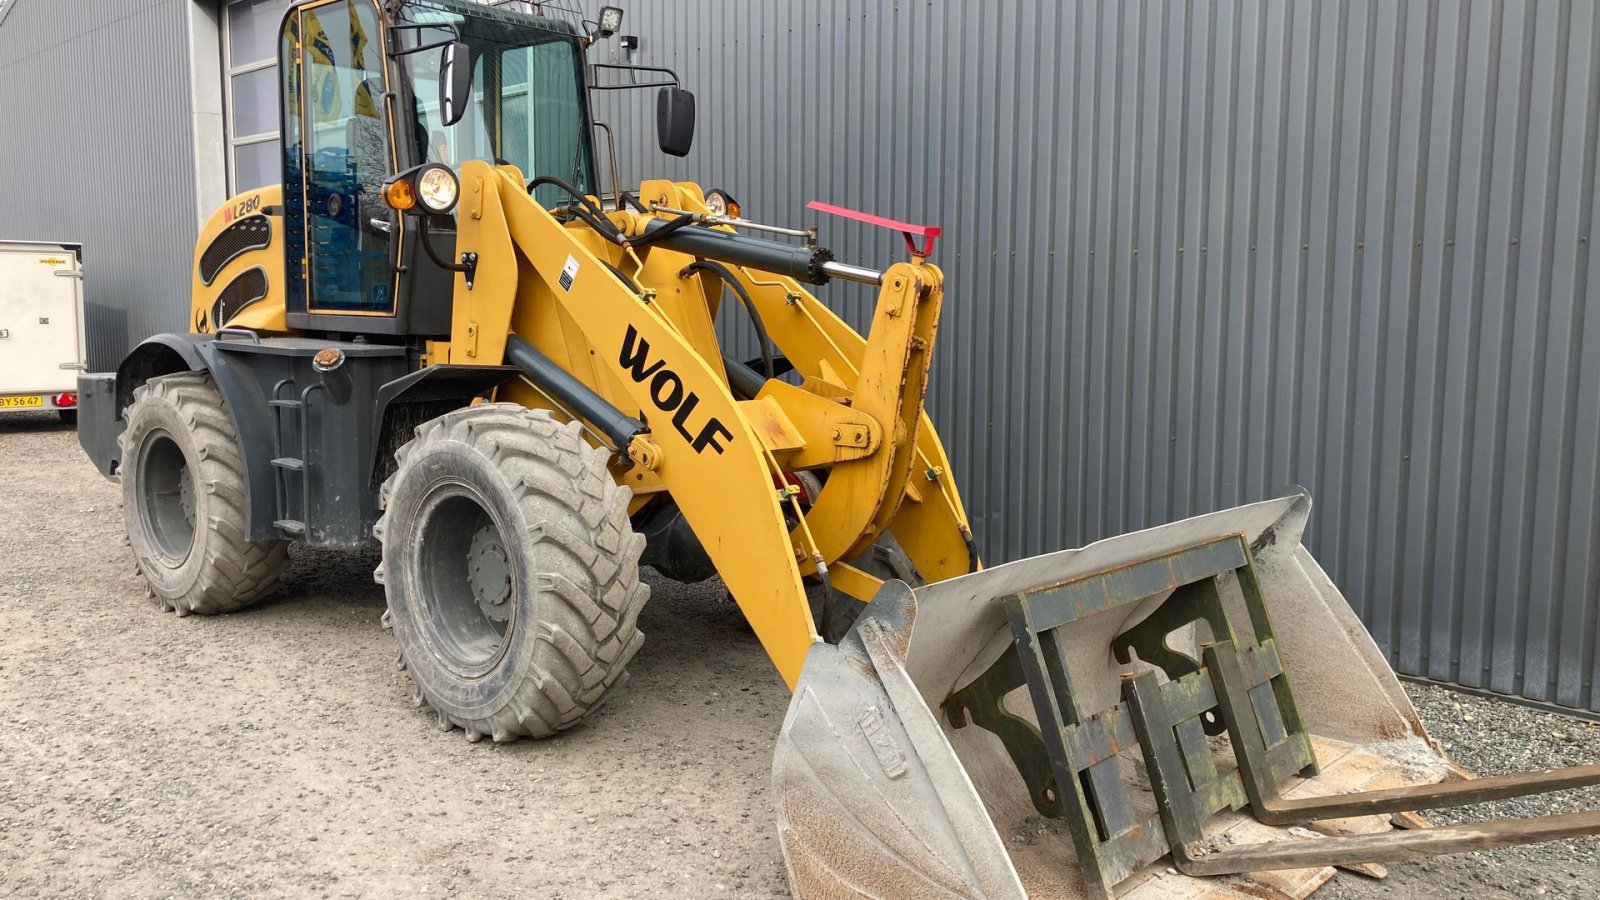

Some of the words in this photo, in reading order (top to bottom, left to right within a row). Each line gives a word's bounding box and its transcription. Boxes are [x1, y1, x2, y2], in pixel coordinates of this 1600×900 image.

[224, 195, 260, 223] WL280
[13, 397, 25, 406] 56
[27, 397, 39, 405] 47
[619, 323, 734, 455] WOLF
